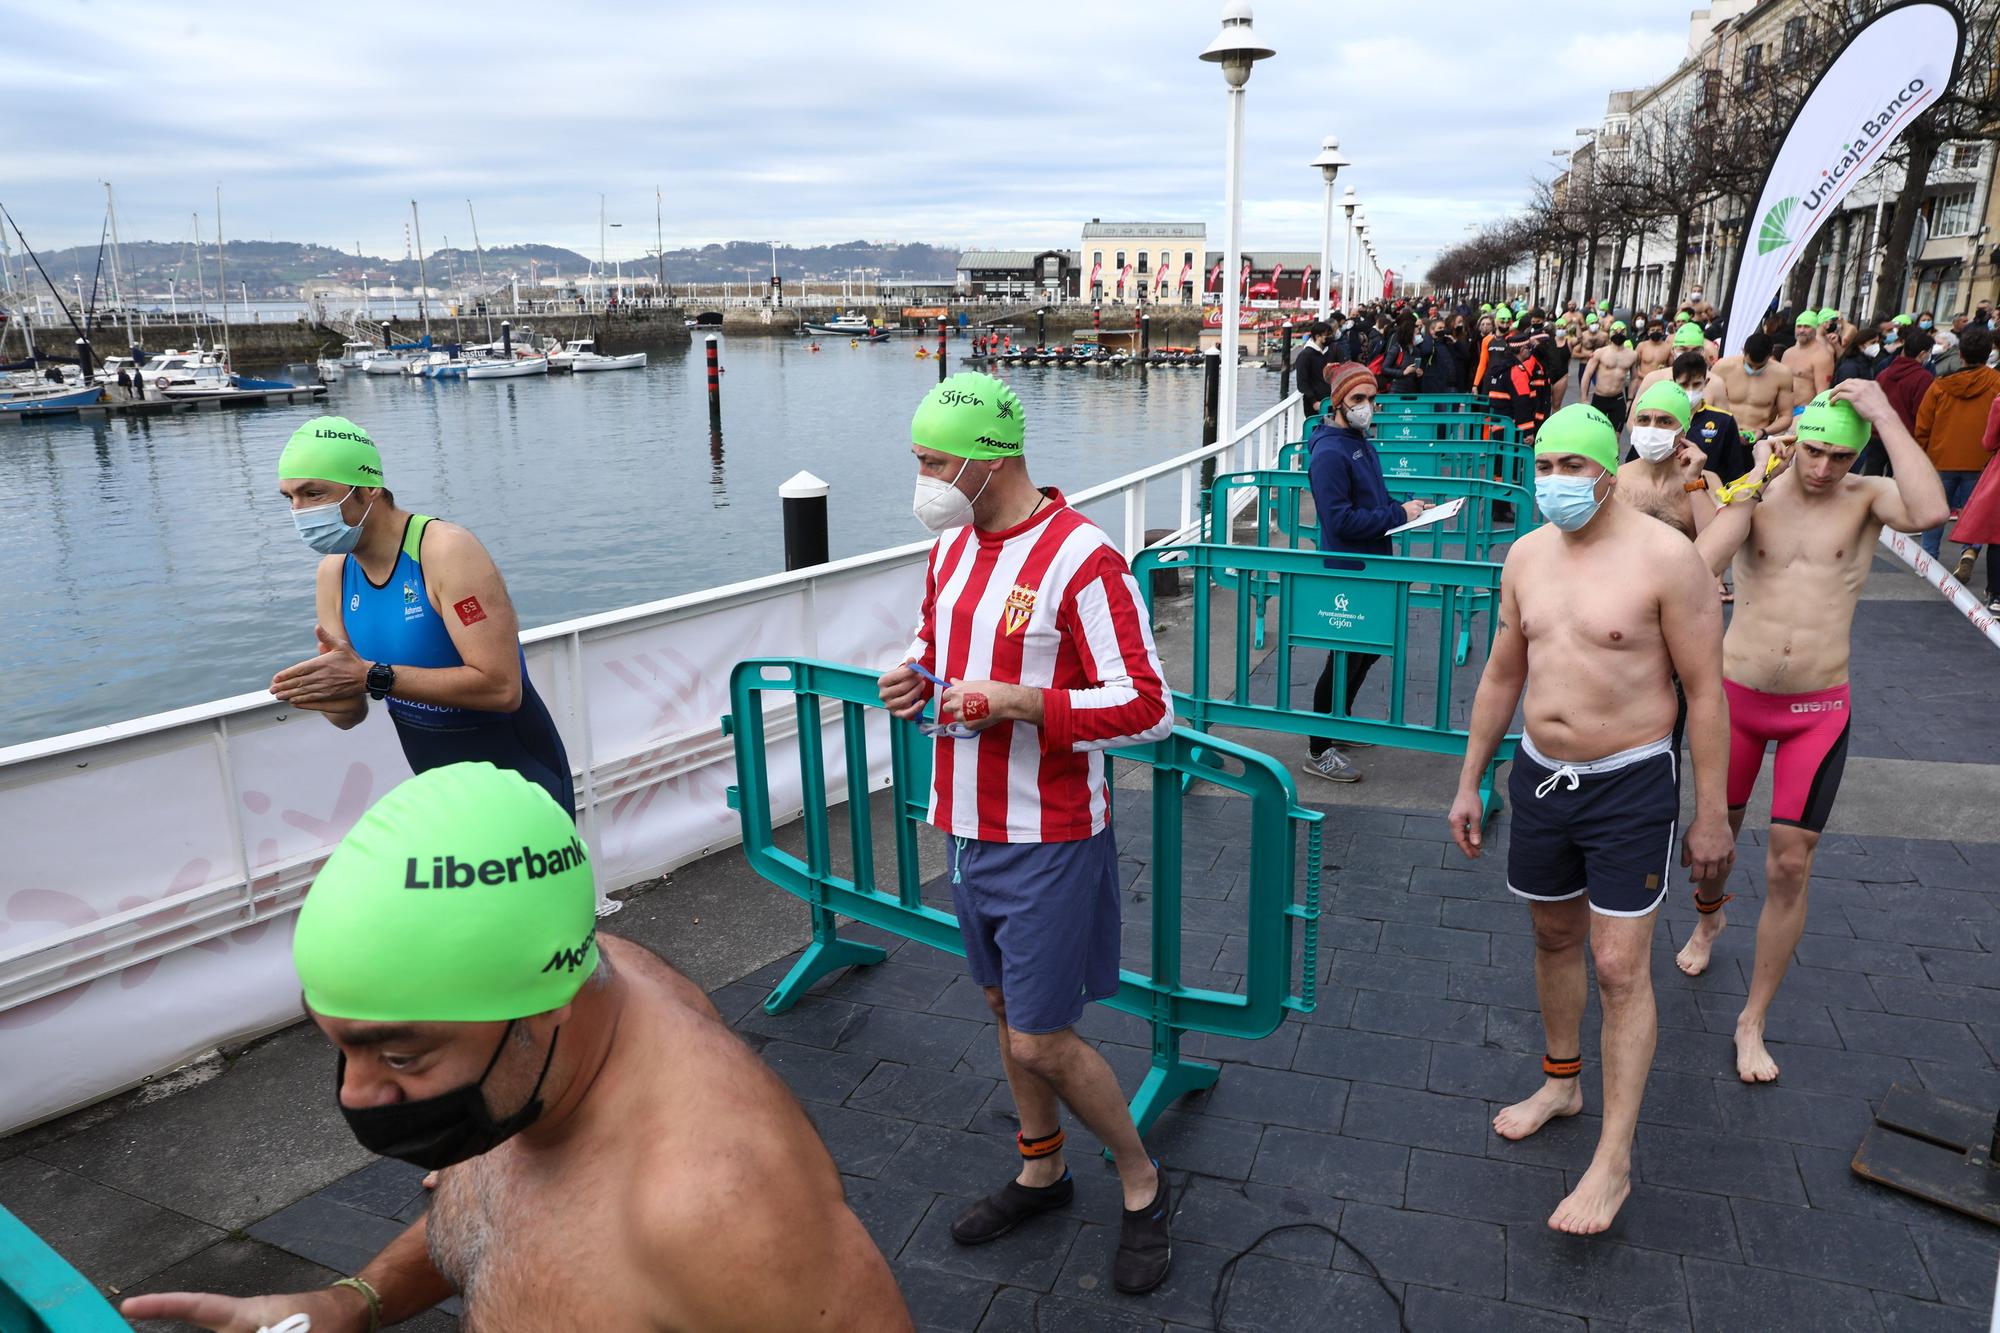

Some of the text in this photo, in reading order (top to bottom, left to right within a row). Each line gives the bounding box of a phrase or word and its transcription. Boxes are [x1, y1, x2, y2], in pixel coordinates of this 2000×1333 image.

[1802, 78, 1925, 211] Unicaja Banco
[938, 389, 985, 407] gijón
[974, 435, 1019, 450] Mosconi
[966, 700, 978, 716] 52
[1790, 700, 1843, 713] arena
[403, 836, 587, 890] Liberbank
